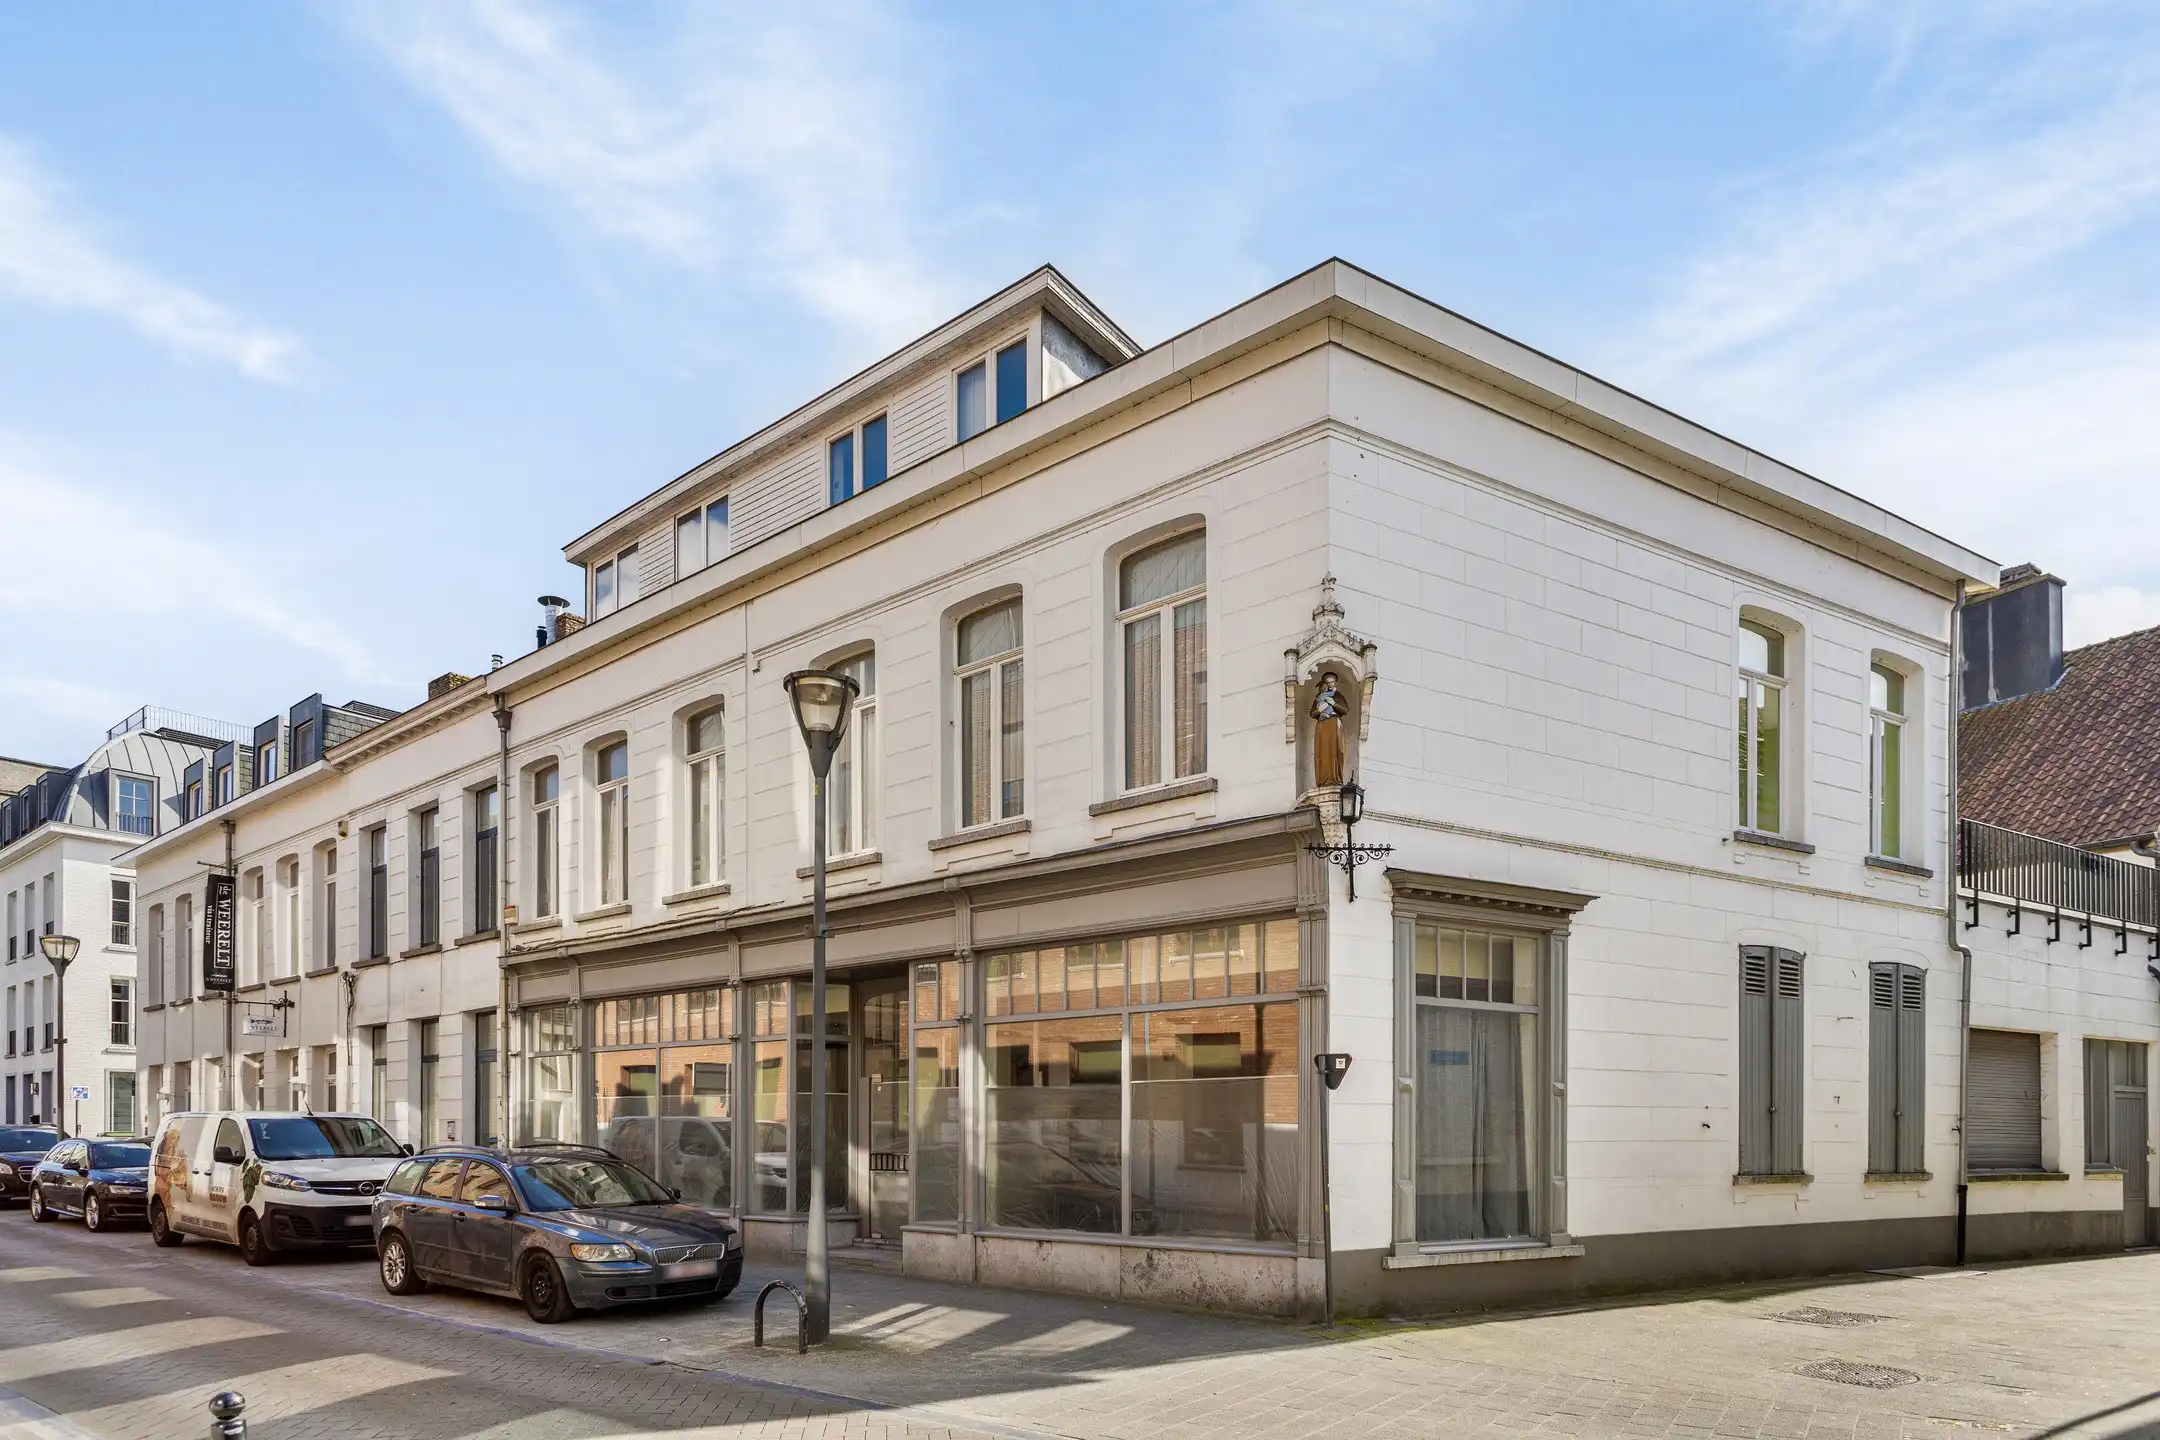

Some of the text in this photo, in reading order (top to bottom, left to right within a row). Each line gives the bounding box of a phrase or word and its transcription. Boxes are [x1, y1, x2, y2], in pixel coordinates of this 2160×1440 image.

[205, 918, 213, 944] traiteur
[217, 886, 231, 967] de WEERELT
